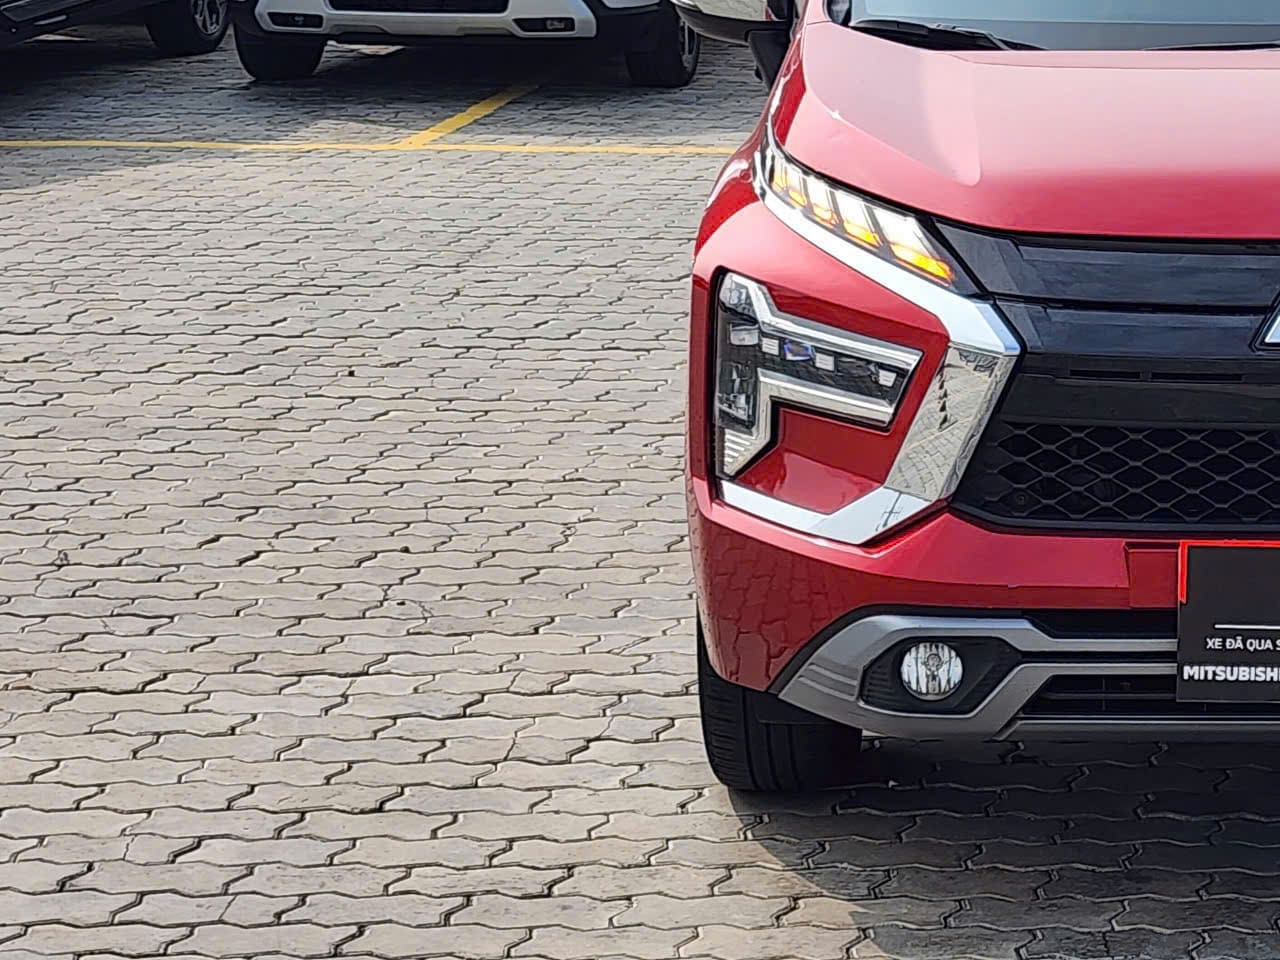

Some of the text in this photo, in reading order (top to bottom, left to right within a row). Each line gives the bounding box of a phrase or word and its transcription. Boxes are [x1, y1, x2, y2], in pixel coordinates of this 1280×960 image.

[1206, 638, 1222, 649] XE
[1226, 636, 1244, 650] ĐÃ
[1246, 638, 1273, 653] QUA
